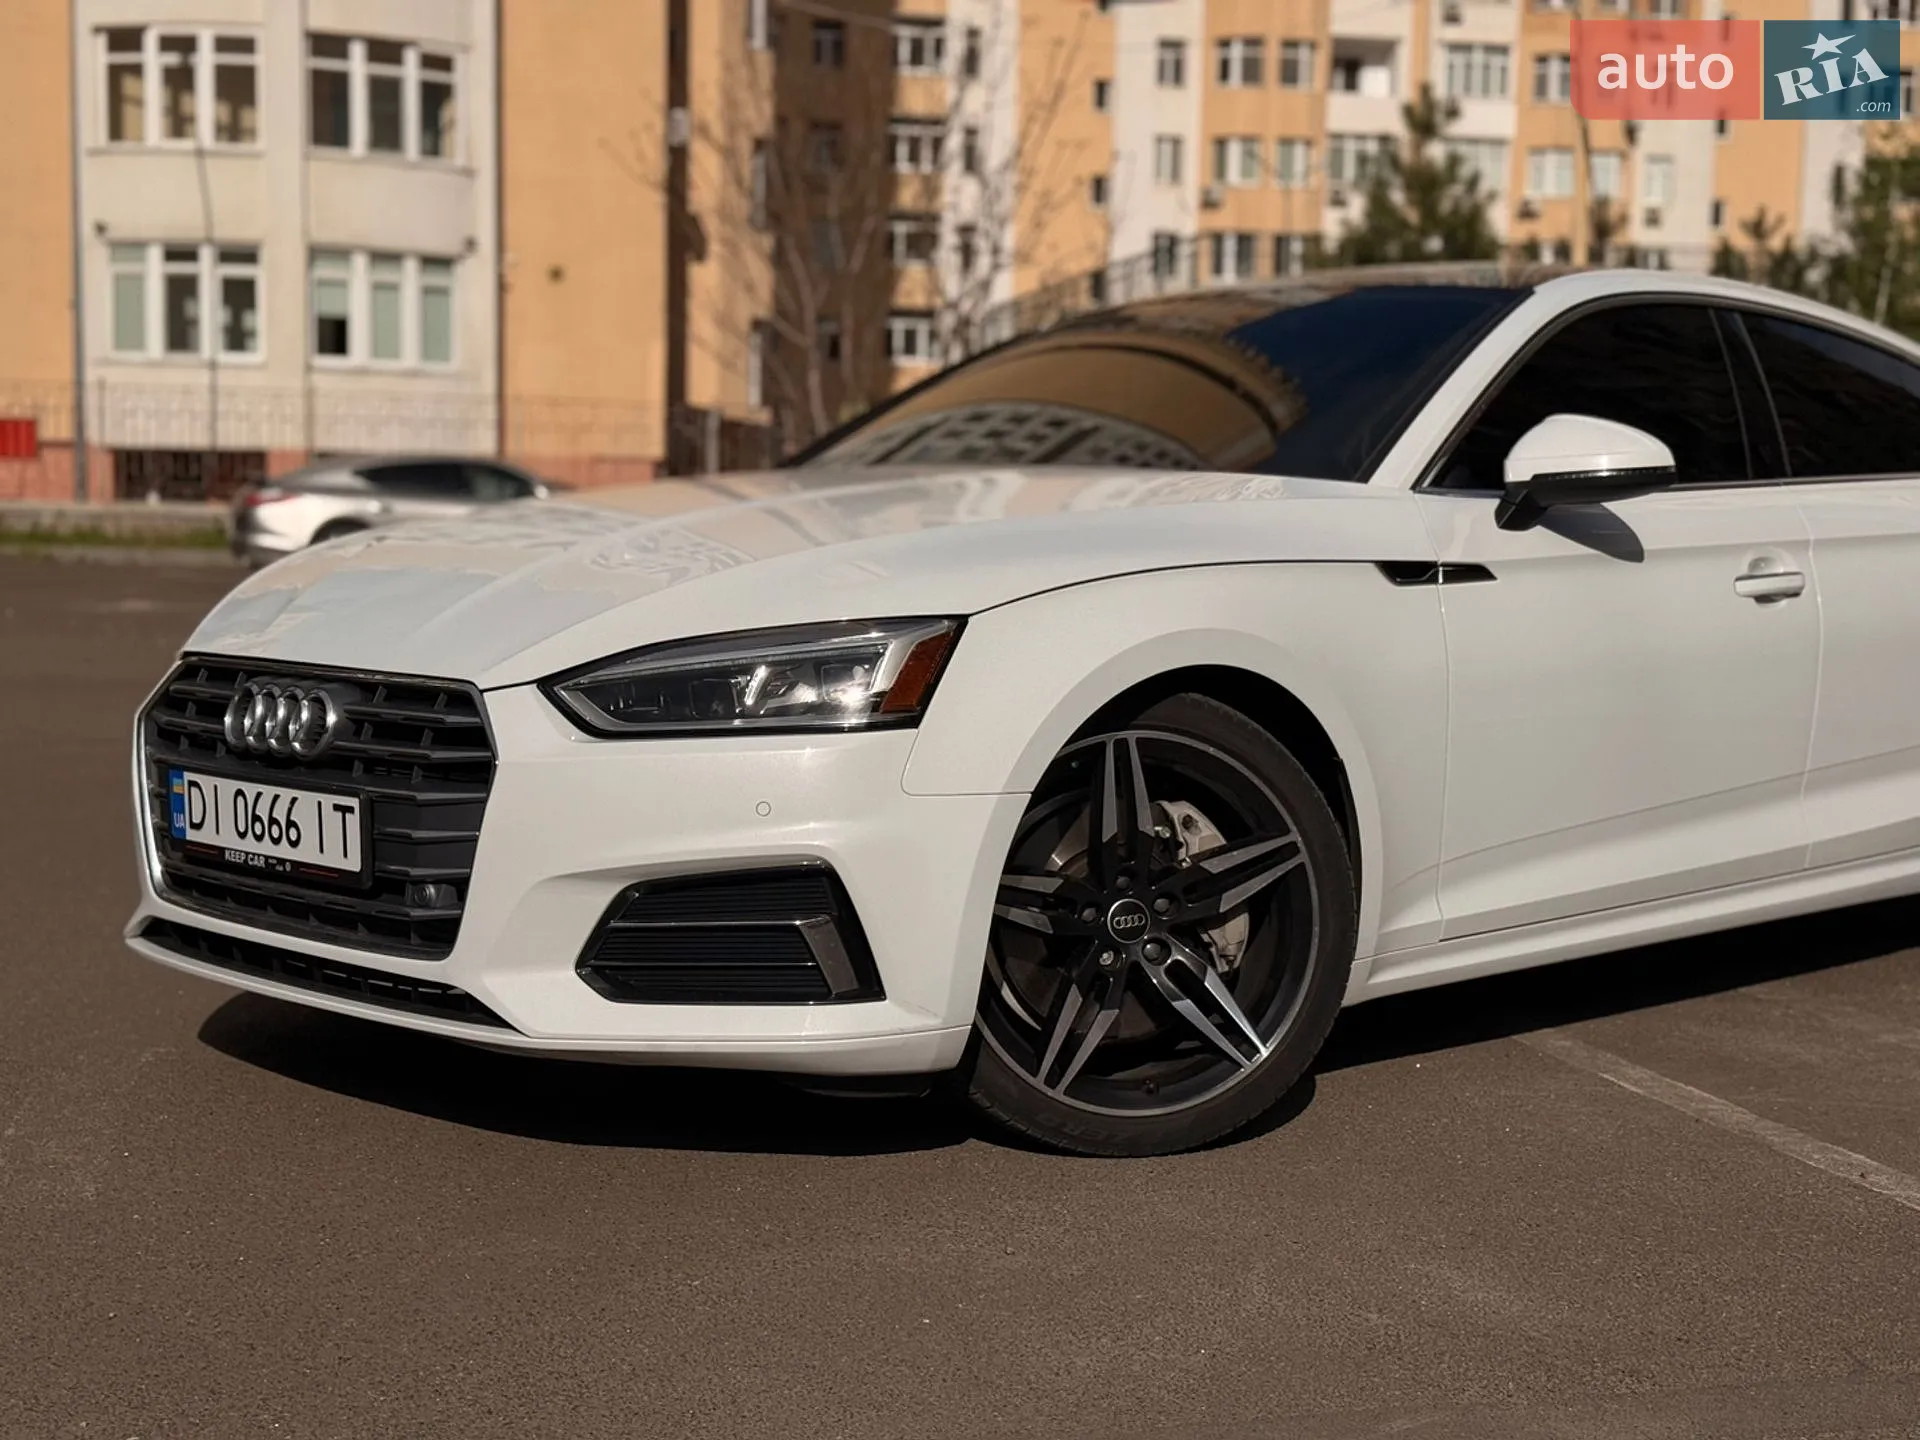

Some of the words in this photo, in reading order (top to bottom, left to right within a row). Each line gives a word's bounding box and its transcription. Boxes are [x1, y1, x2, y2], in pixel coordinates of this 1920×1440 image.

[173, 813, 185, 828] UA
[187, 780, 219, 836] DI
[233, 788, 302, 849] 0666
[317, 799, 355, 859] IT
[224, 849, 246, 864] KEEP
[248, 853, 265, 868] CAR
